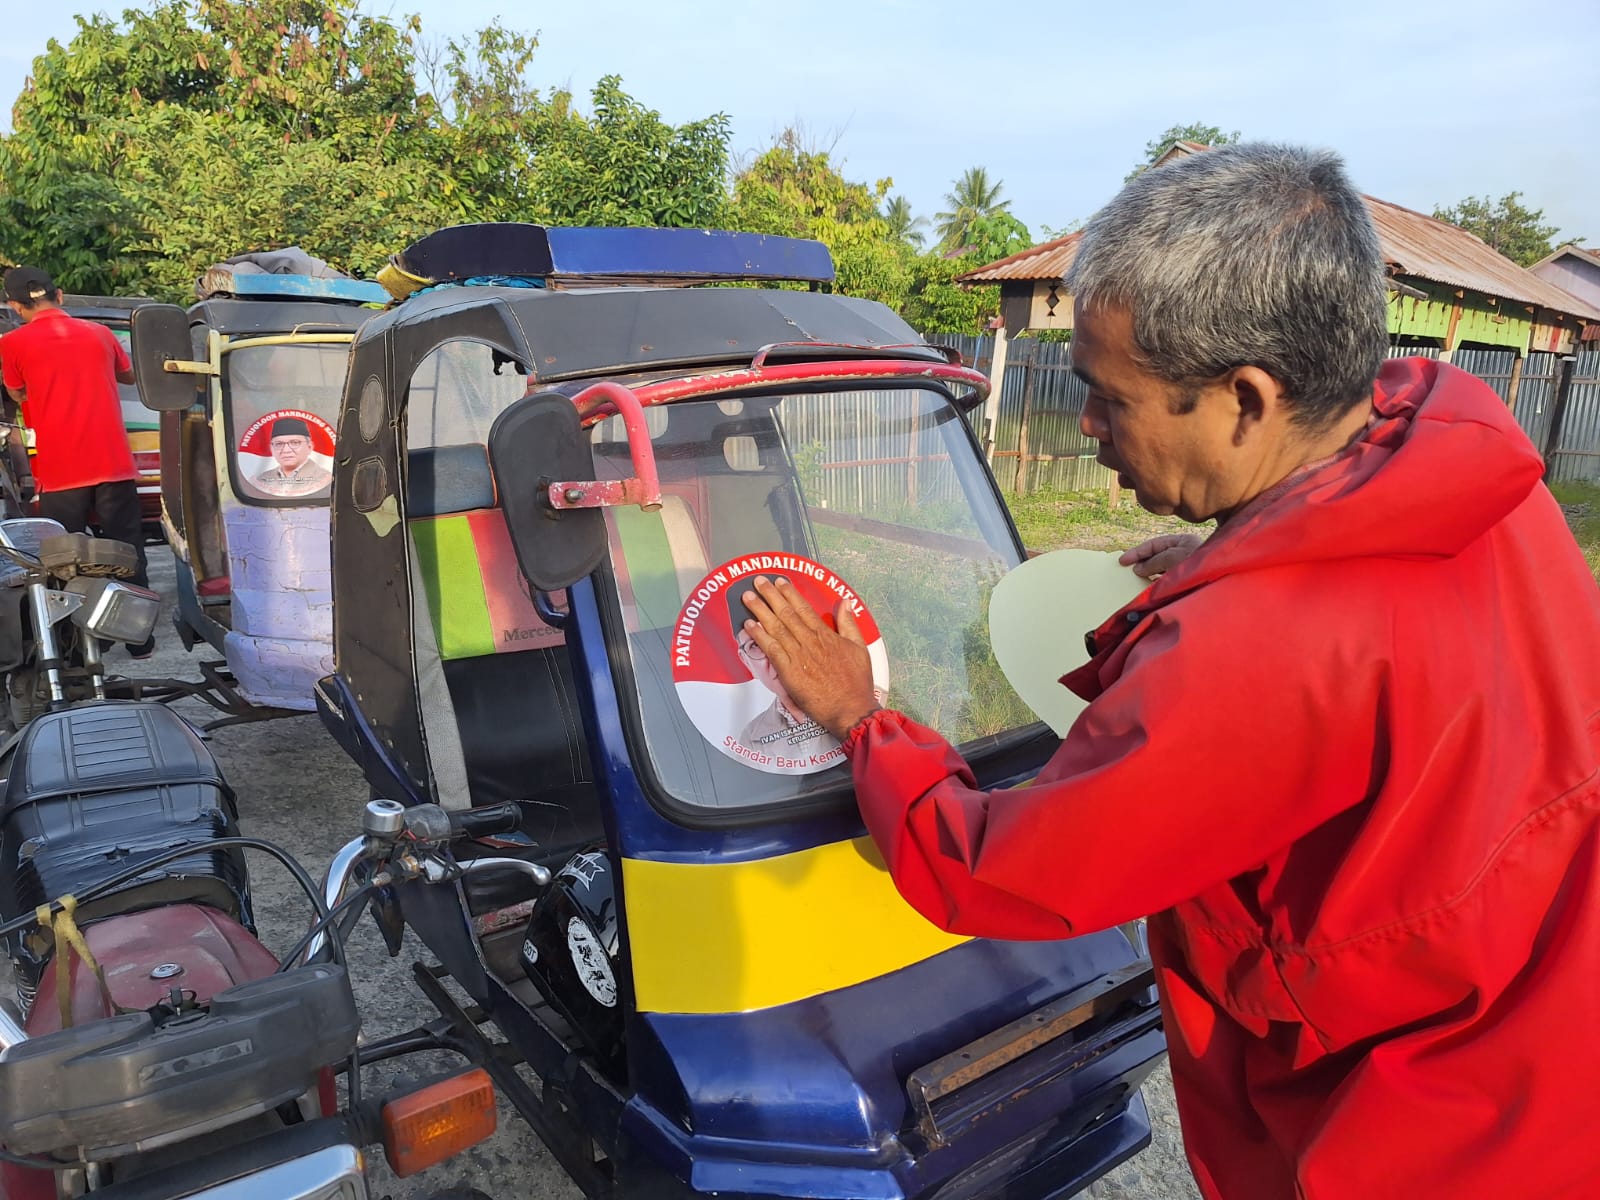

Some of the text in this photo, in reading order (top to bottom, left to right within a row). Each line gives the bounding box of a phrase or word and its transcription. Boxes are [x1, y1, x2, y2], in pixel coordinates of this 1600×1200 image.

[278, 411, 325, 428] MANDAILING
[676, 556, 864, 667] PATUJOLOON MANDAILING NATAL
[760, 732, 780, 744] IVAN
[723, 735, 843, 768] Standar Baru Kema
